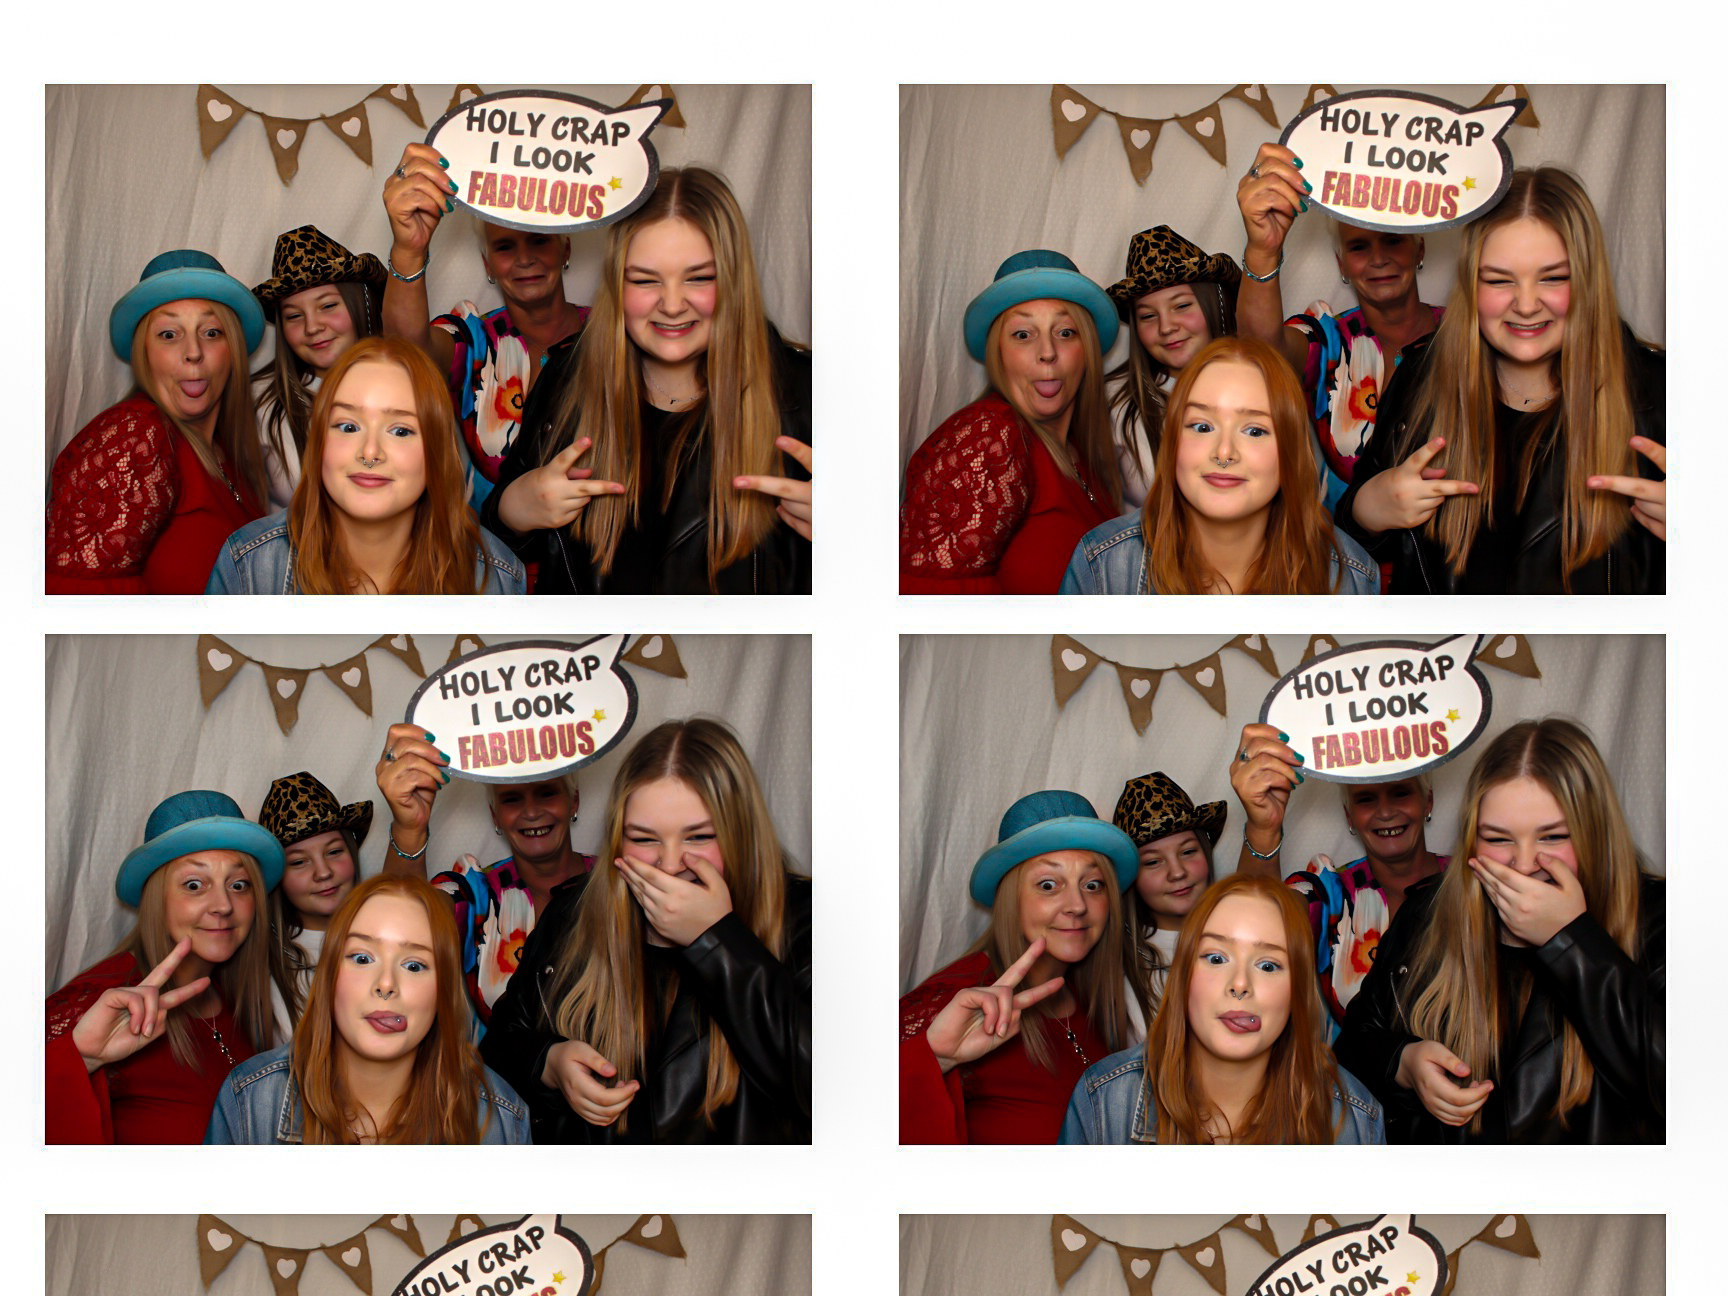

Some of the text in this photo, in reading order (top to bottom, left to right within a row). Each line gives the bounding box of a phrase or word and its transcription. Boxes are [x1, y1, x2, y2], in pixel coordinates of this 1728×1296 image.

[466, 107, 630, 147] HOLY CRAP
[1320, 107, 1484, 147] HOLY CRAP
[490, 141, 596, 175] I LOOK
[1344, 141, 1450, 175] I LOOK
[467, 170, 606, 220] FABULOUS
[1321, 170, 1460, 220] FABULOUS
[439, 655, 600, 700] HOLY CRAP
[1293, 655, 1454, 700] HOLY CRAP
[471, 692, 575, 725] I LOOK
[1325, 692, 1429, 725] I LOOK
[457, 721, 595, 770] FABULOUS
[1311, 721, 1449, 770] FABULOUS
[478, 1225, 545, 1273] CRAP
[1332, 1225, 1399, 1273] CRAP
